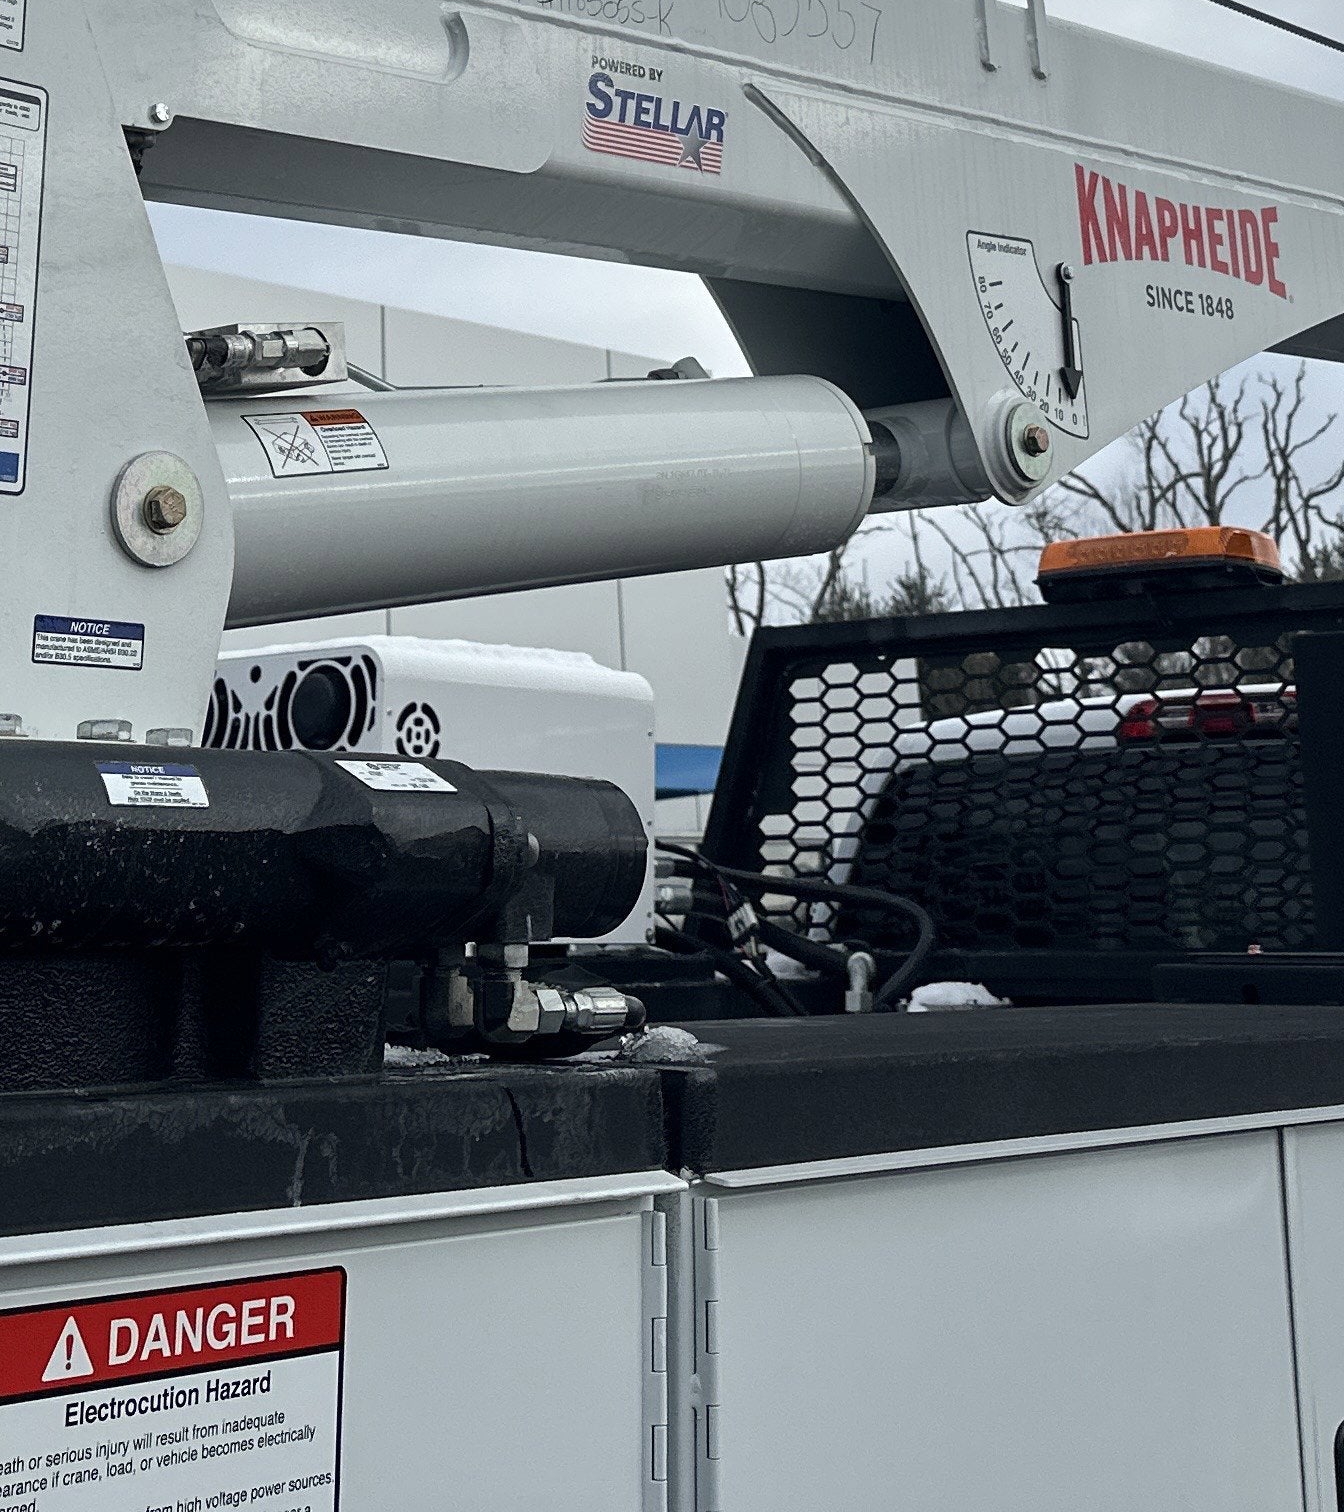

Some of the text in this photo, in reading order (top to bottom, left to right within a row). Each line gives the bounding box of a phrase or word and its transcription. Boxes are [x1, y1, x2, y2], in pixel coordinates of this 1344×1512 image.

[591, 54, 664, 82] POWERED BY
[585, 71, 726, 143] STELLAR
[1074, 162, 1287, 300] KNAPHEIDE
[976, 238, 1027, 257] Angle Indicator
[977, 275, 988, 294] 80
[983, 301, 994, 320] 70
[1145, 284, 1234, 320] SINCE 1848
[992, 326, 1003, 346] 60
[1000, 347, 1013, 367] 50
[1013, 369, 1025, 386] 40
[1025, 385, 1037, 402] 30
[1038, 398, 1050, 414] 20
[1054, 408, 1064, 422] 10
[69, 621, 111, 635] NOTICE
[107, 1295, 296, 1367] DANGER
[64, 1369, 272, 1428] Electrocution Hazard
[28, 1455, 43, 1471] or
[45, 1446, 93, 1468] serious
[95, 1439, 130, 1461] injury
[132, 1431, 153, 1451] will
[155, 1426, 189, 1447] result
[192, 1423, 219, 1440] from
[221, 1410, 286, 1435] inadequate
[51, 1470, 60, 1489] if
[62, 1467, 103, 1487] crane,
[105, 1457, 137, 1478] load,
[139, 1456, 154, 1472] or
[156, 1447, 198, 1469] vehicle
[201, 1438, 255, 1460] becomes
[257, 1424, 317, 1449] electrically
[205, 1489, 248, 1509] voltage
[250, 1481, 287, 1504] power
[288, 1472, 335, 1492] sources.
